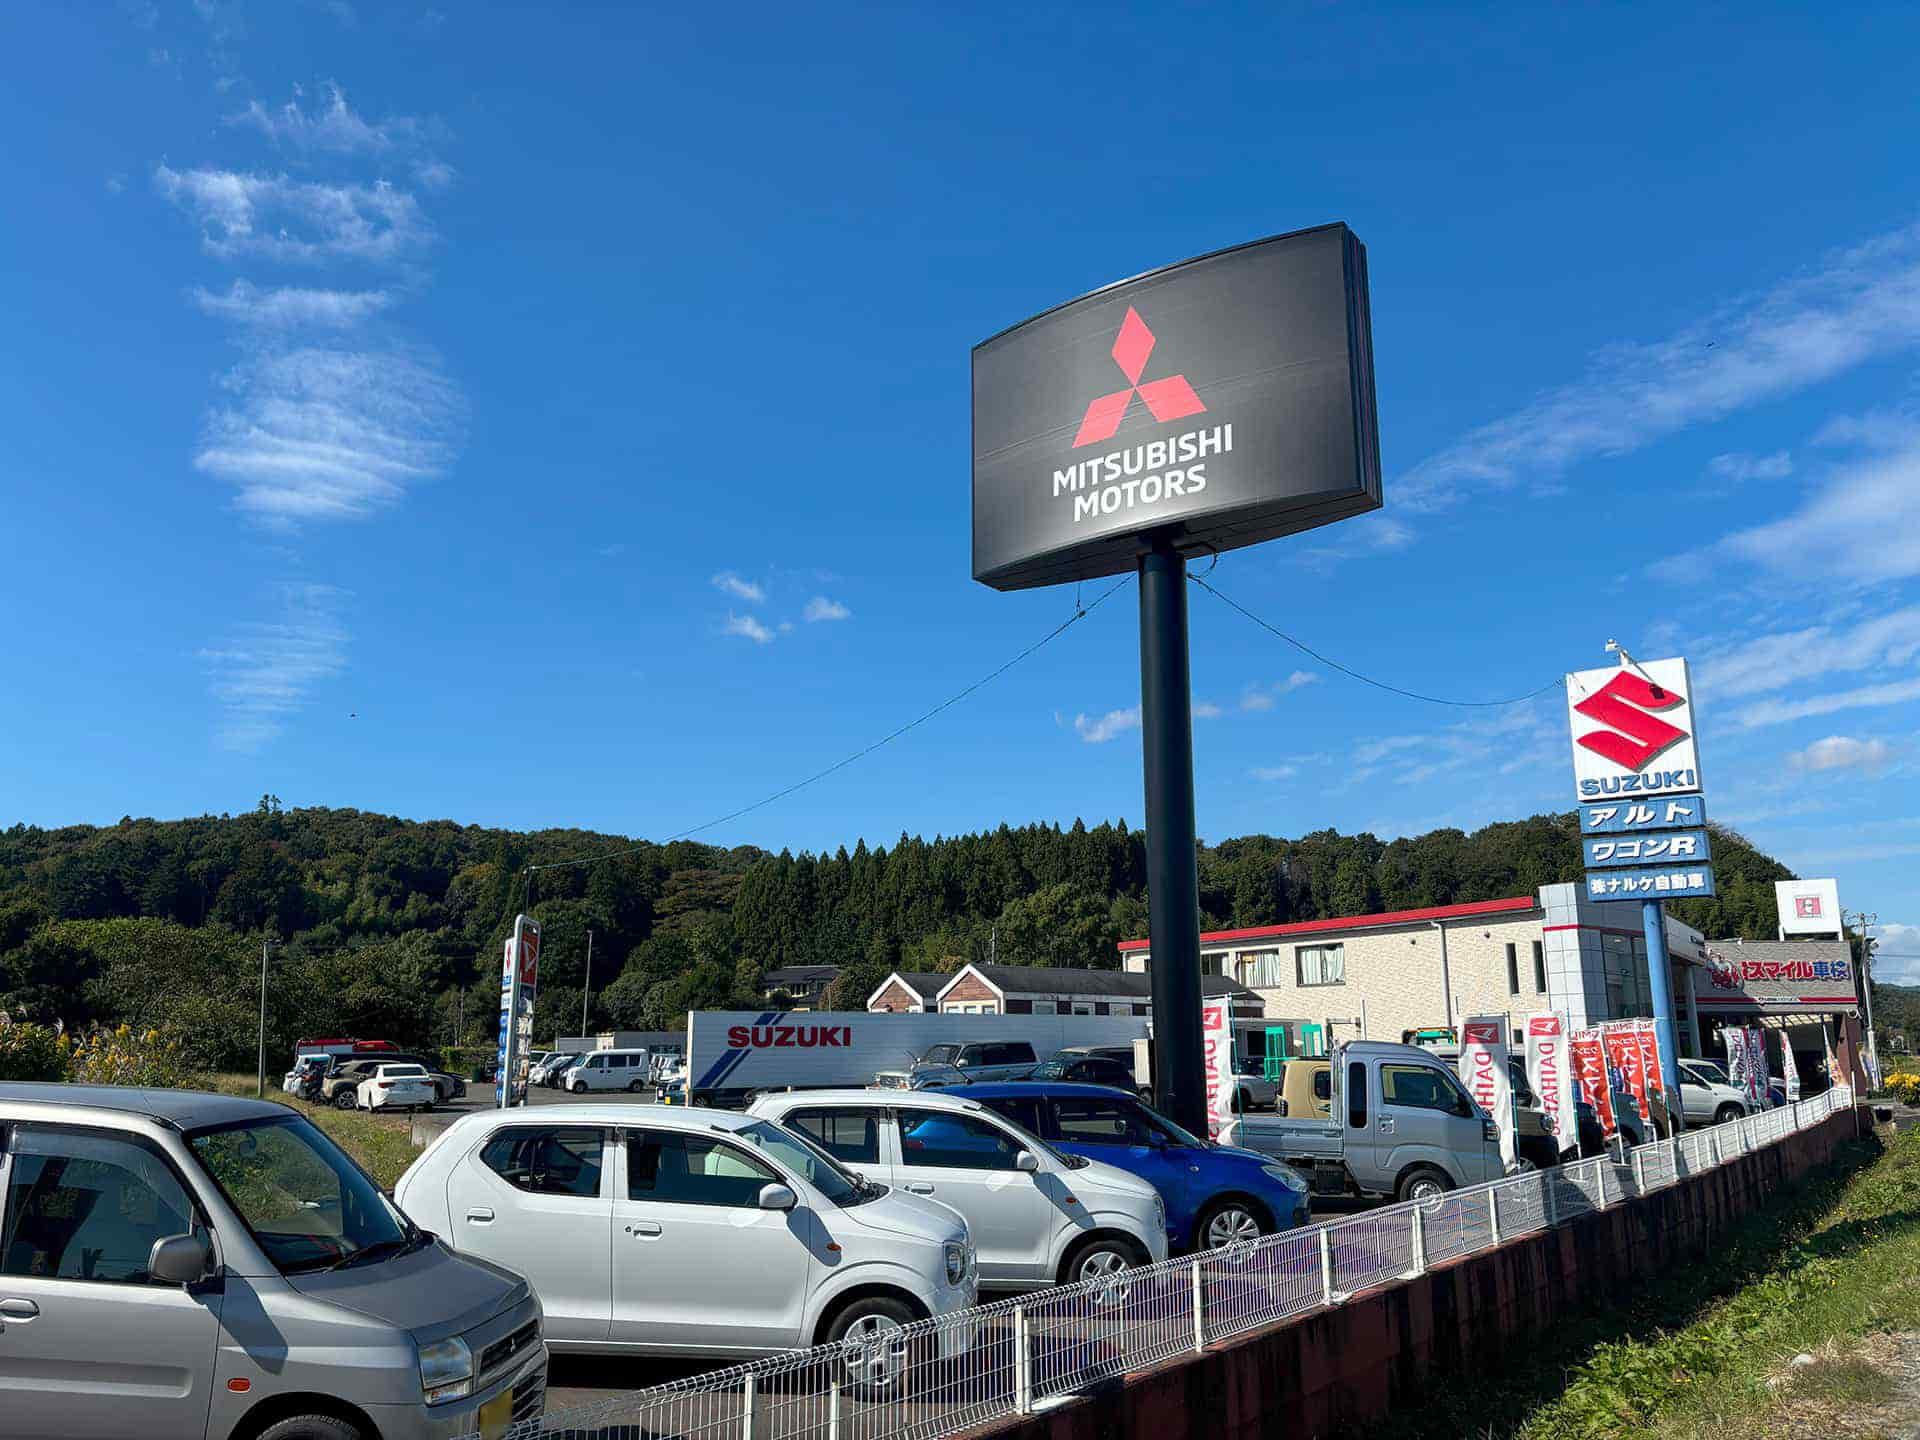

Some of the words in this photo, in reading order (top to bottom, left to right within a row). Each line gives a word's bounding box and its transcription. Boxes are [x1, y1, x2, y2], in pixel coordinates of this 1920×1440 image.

[1053, 423, 1233, 497] MITSUBISHI
[1074, 463, 1207, 522] MOTORS
[1580, 769, 1696, 796] SUZUKI
[1588, 802, 1694, 828] アルト
[1591, 836, 1697, 862] ワゴンR
[727, 1026, 852, 1048] SUZUKI
